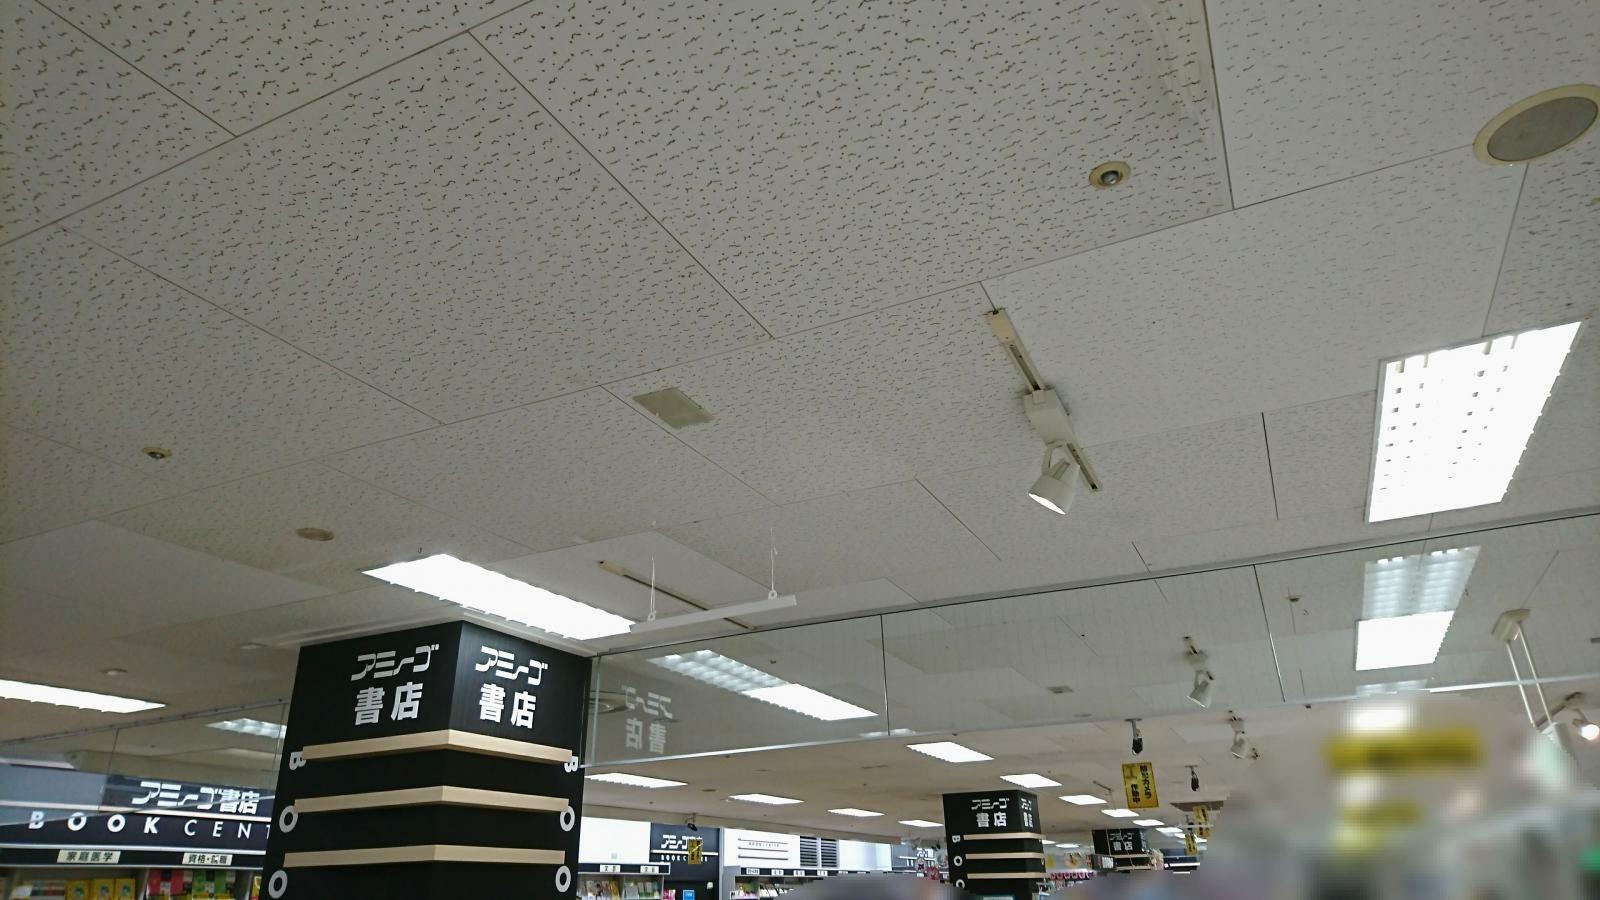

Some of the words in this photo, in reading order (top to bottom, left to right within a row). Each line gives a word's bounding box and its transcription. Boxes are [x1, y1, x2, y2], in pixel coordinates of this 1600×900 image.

[351, 644, 439, 681] アミーゴ
[475, 645, 548, 686] アミーゴ
[355, 682, 424, 726] 書店
[479, 683, 537, 729] 書店
[131, 781, 260, 815] アミーゴ書店
[971, 798, 1010, 810] アミーゴ
[28, 811, 161, 834] BOOK
[976, 812, 1007, 828] 書店
